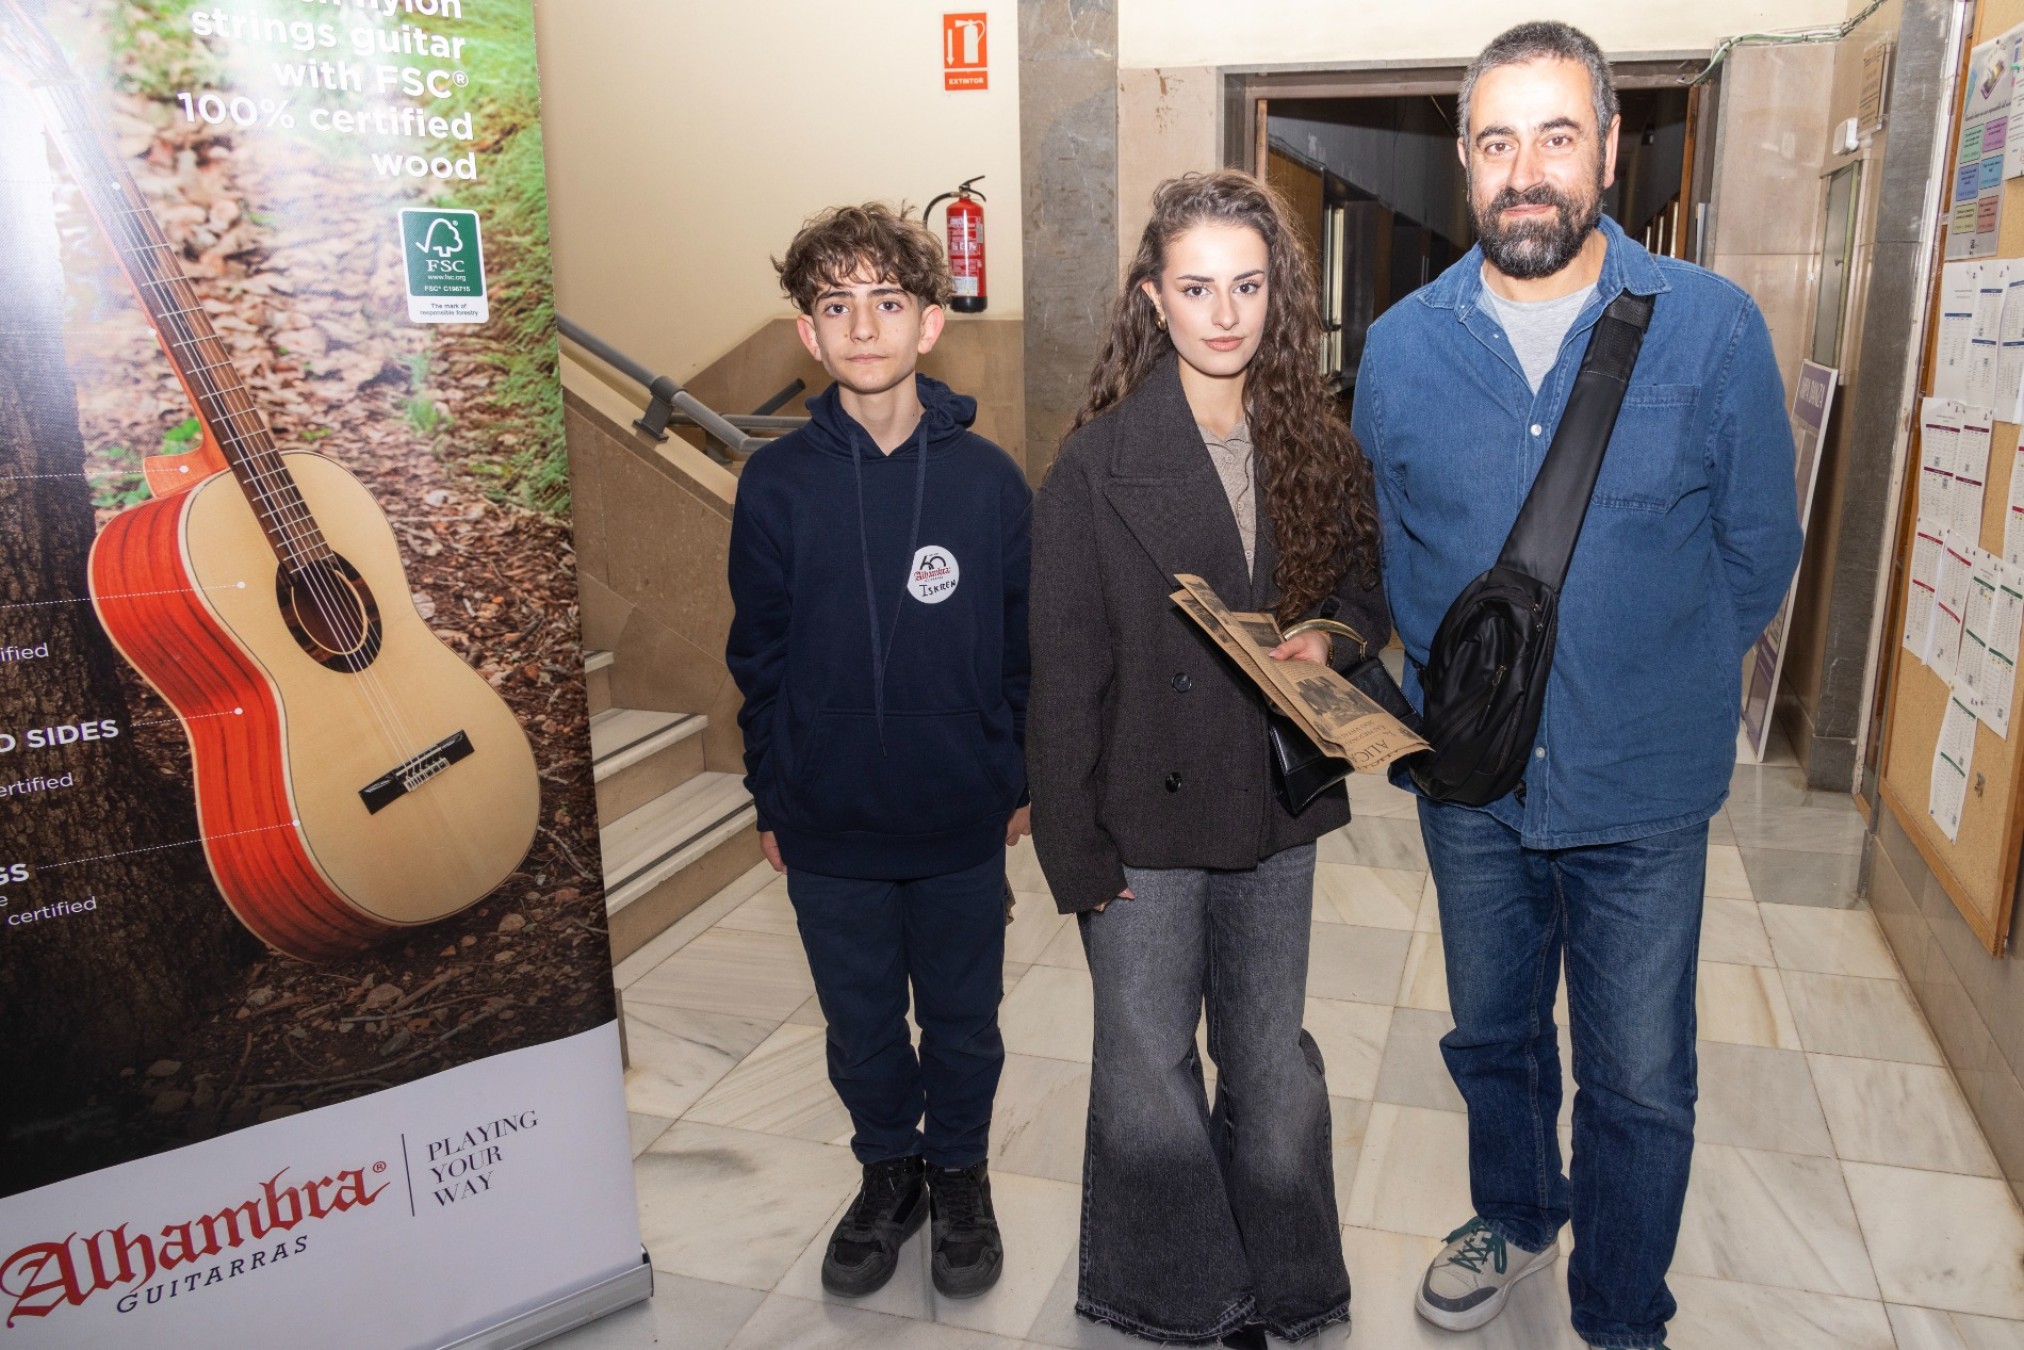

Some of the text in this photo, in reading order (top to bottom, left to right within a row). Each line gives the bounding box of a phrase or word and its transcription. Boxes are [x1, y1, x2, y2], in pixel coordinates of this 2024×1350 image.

[191, 8, 466, 59] strings guitar
[271, 59, 362, 92] with
[177, 92, 475, 140] 100% certified
[371, 152, 478, 180] wood
[426, 260, 465, 272] FSC
[27, 719, 119, 748] SIDES
[8, 896, 97, 926] certified
[426, 1110, 539, 1162] PLAYING
[429, 1145, 503, 1184] YOUR
[432, 1170, 494, 1206] WAY
[116, 1235, 309, 1313] GUITARRAS
